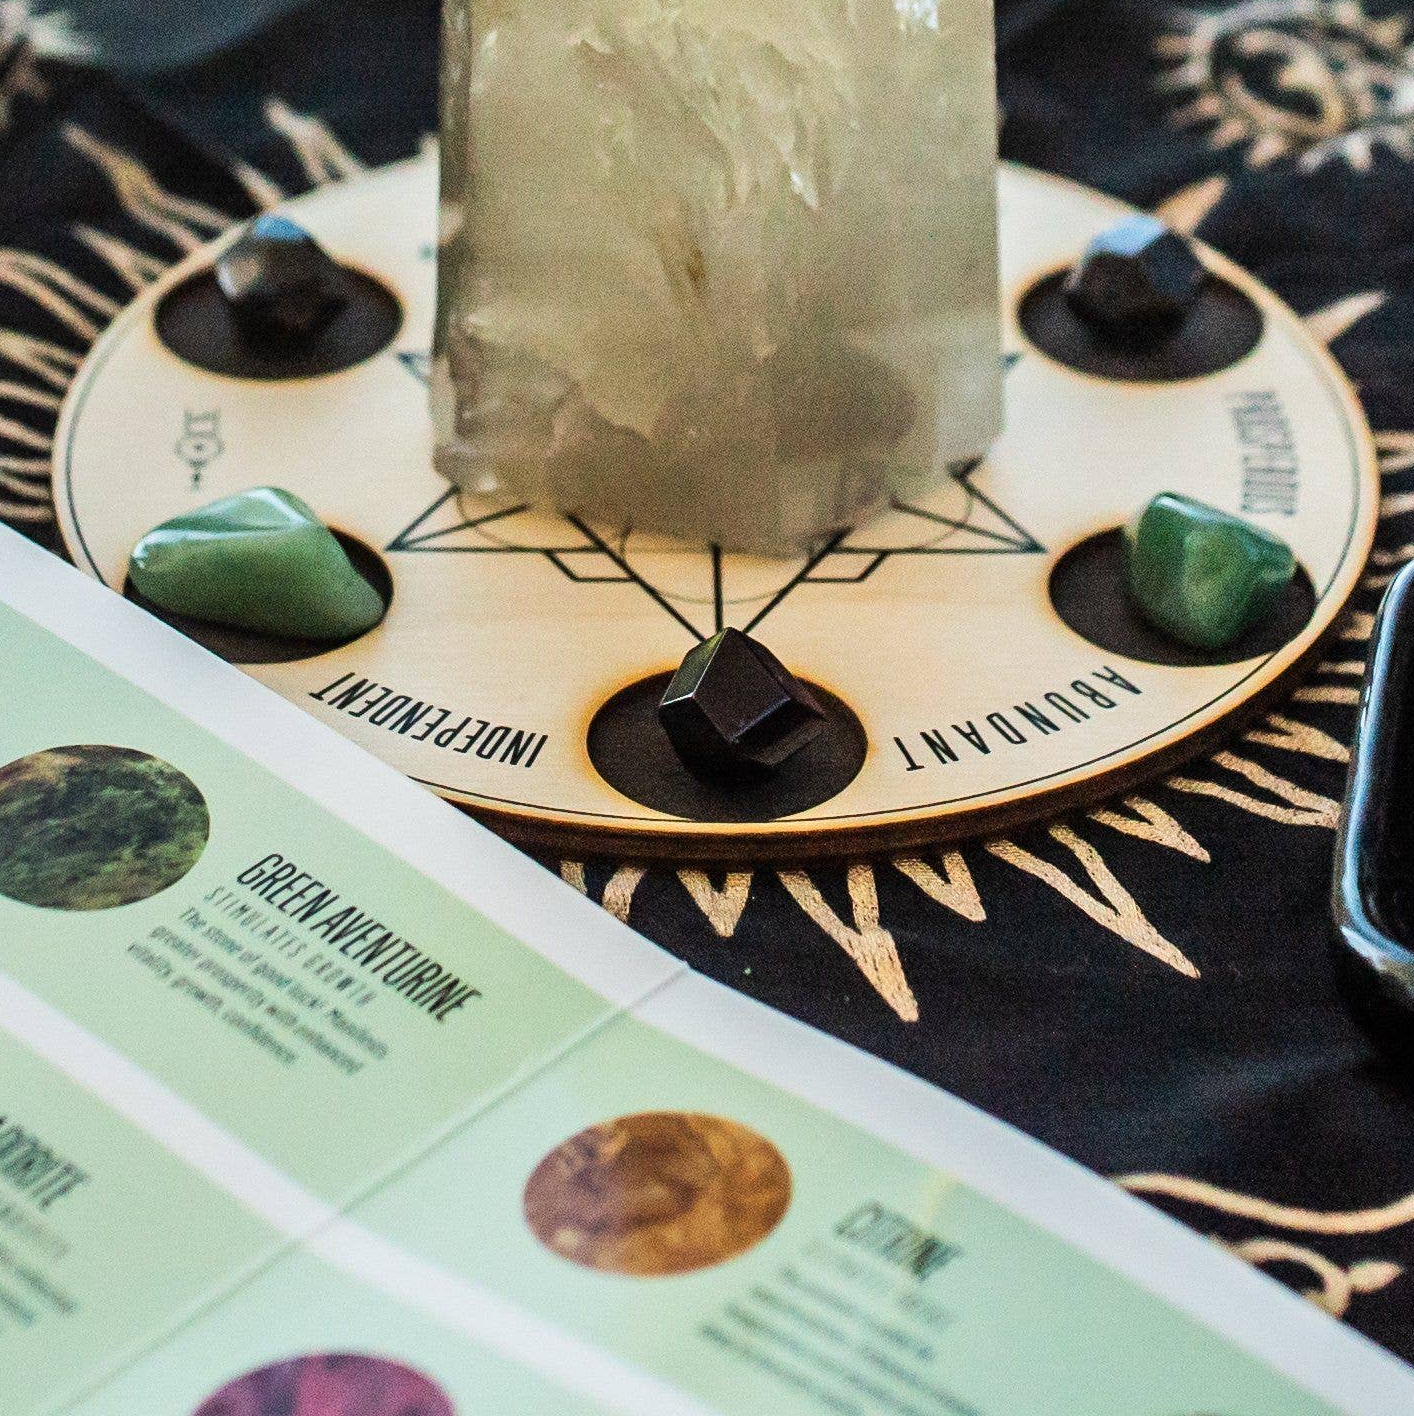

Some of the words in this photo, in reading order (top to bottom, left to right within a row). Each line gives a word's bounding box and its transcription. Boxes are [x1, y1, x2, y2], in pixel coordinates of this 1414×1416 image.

[307, 671, 549, 768] INDEPENDENT
[893, 665, 1143, 772] ABUNDANT
[236, 852, 340, 924] GREEN
[308, 905, 483, 1023] AVENTURINE
